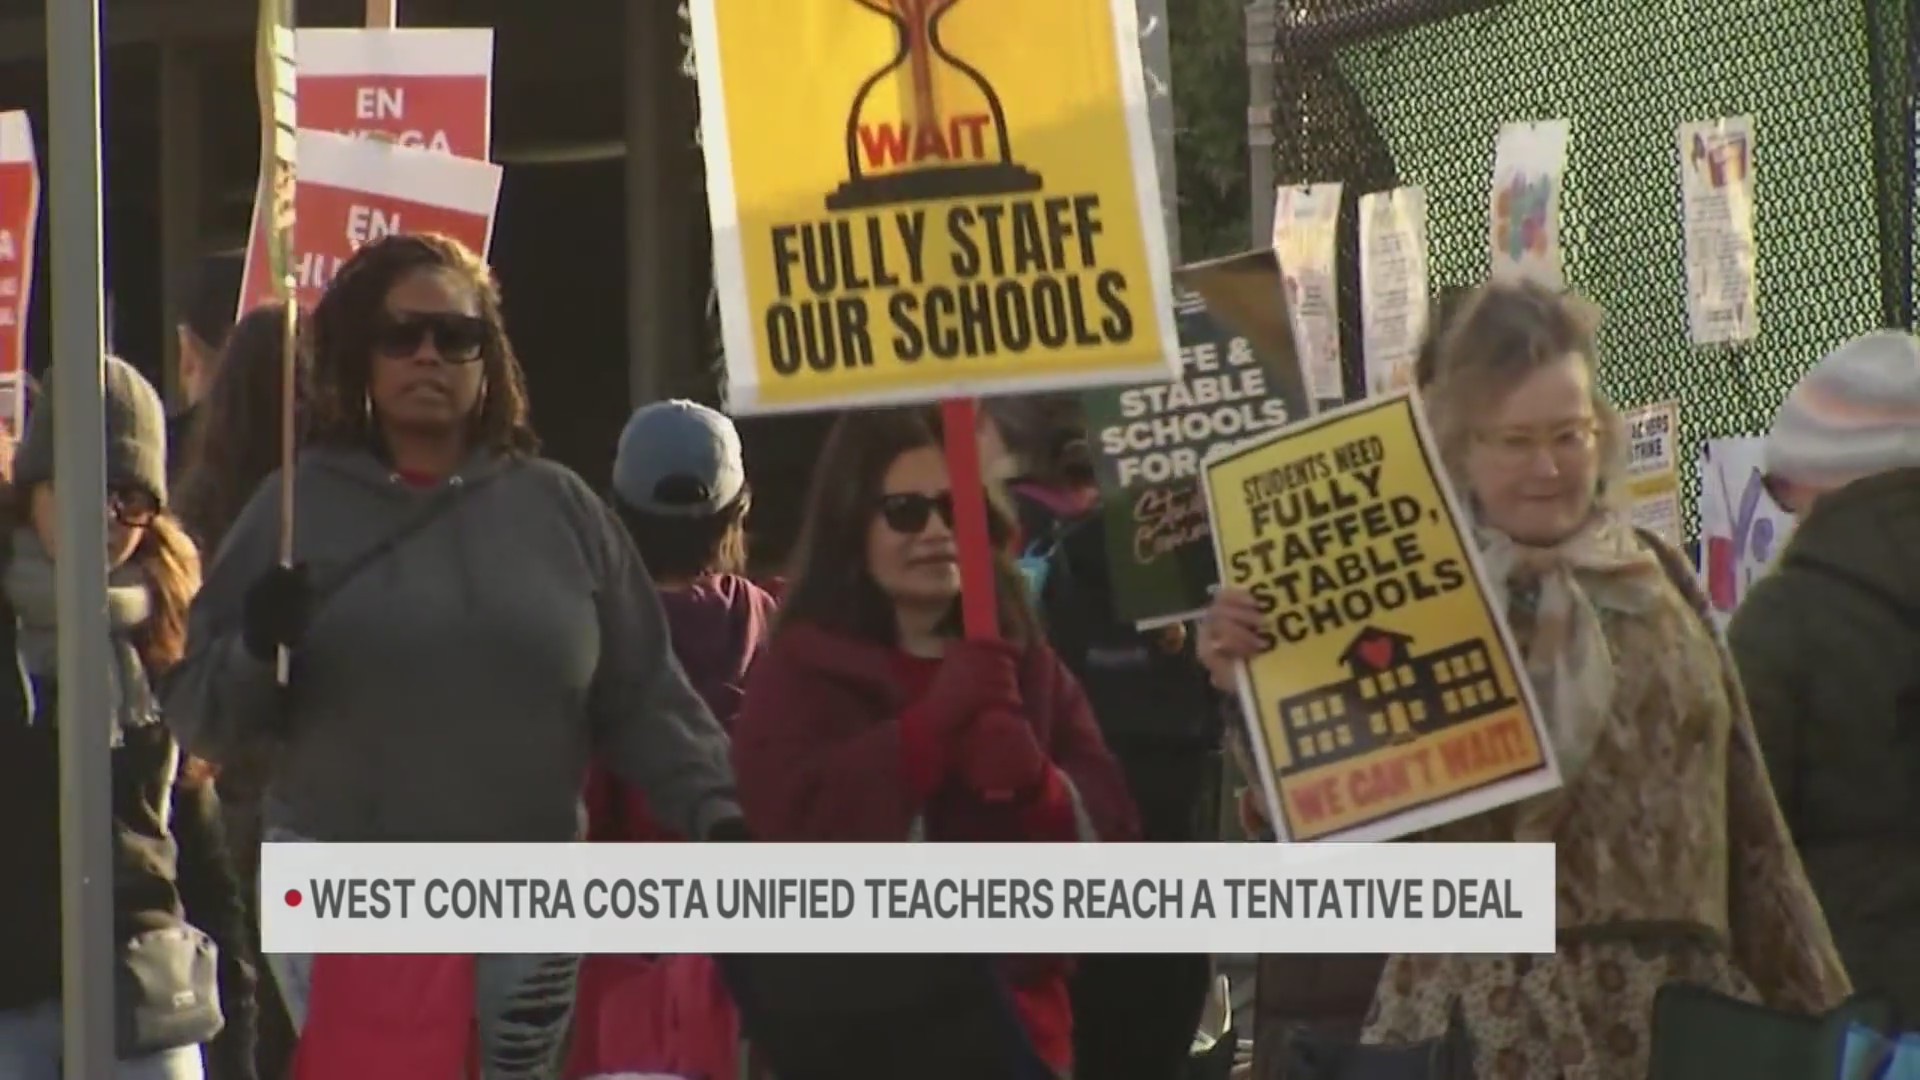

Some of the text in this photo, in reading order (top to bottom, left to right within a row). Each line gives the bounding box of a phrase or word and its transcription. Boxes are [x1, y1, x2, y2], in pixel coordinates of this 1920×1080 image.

[355, 86, 404, 120] EN
[859, 115, 990, 168] WAIT
[346, 204, 401, 242] EN
[771, 194, 1103, 297] FULLY STAFF
[765, 270, 1134, 376] OUR SCHOOLS
[1178, 343, 1219, 371] FE
[1120, 367, 1267, 418] STABLE
[1101, 398, 1288, 454] SCHOOLS
[1118, 447, 1199, 487] FOR
[1242, 435, 1384, 505] STUDENTS NEED
[1250, 465, 1381, 537] FULLY
[1231, 495, 1440, 583] STAFFED,
[1250, 533, 1425, 614] STABLE
[1291, 716, 1532, 824] WE CAN'T WAIT!
